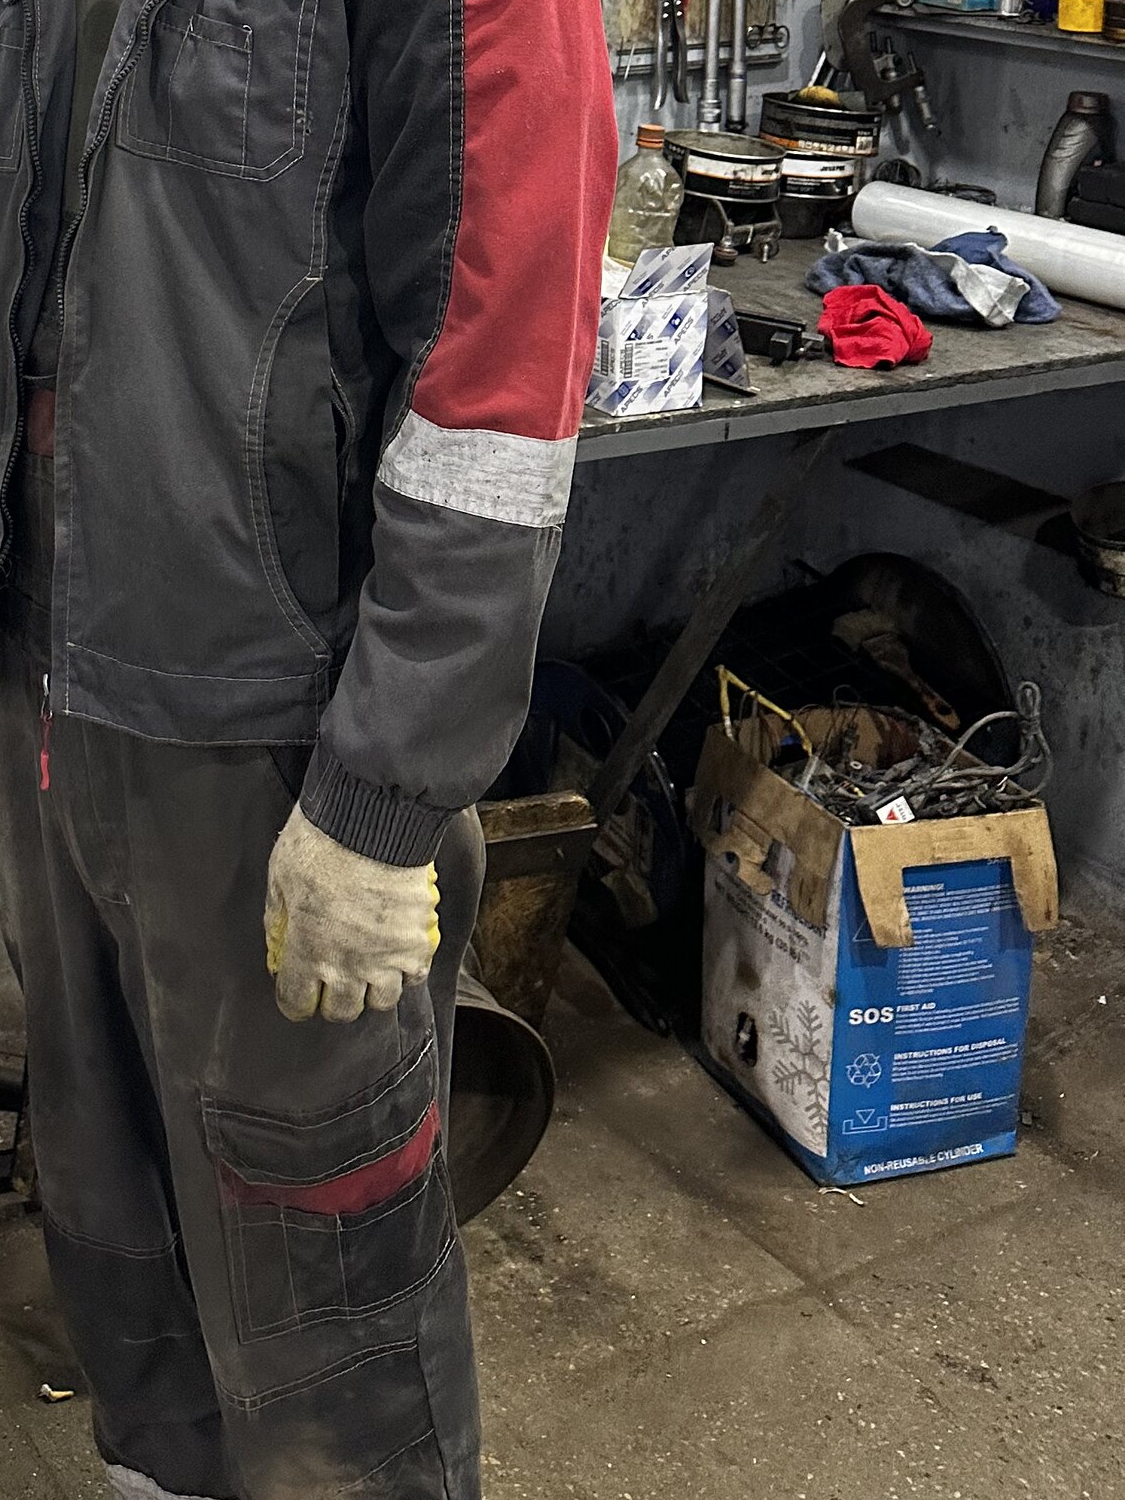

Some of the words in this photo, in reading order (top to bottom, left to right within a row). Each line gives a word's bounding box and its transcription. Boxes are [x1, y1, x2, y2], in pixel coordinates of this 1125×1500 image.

[683, 268, 708, 292] APECS
[674, 317, 694, 345] APECS
[664, 369, 684, 398] APECS
[621, 386, 643, 414] APECS
[848, 1006, 894, 1025] SOS
[896, 1003, 920, 1012] FIRST
[921, 1002, 936, 1010] AID
[894, 1047, 953, 1060] INSTRUCTIONS
[954, 1044, 970, 1053] FOR
[970, 1037, 1007, 1051] DISPOSAL
[890, 1098, 949, 1111] INSTRUCTIONS
[950, 1096, 966, 1104] FOR
[967, 1092, 983, 1101] USE
[863, 1153, 936, 1176] NON-REUSABLE
[937, 1143, 984, 1163] CYLINDER
